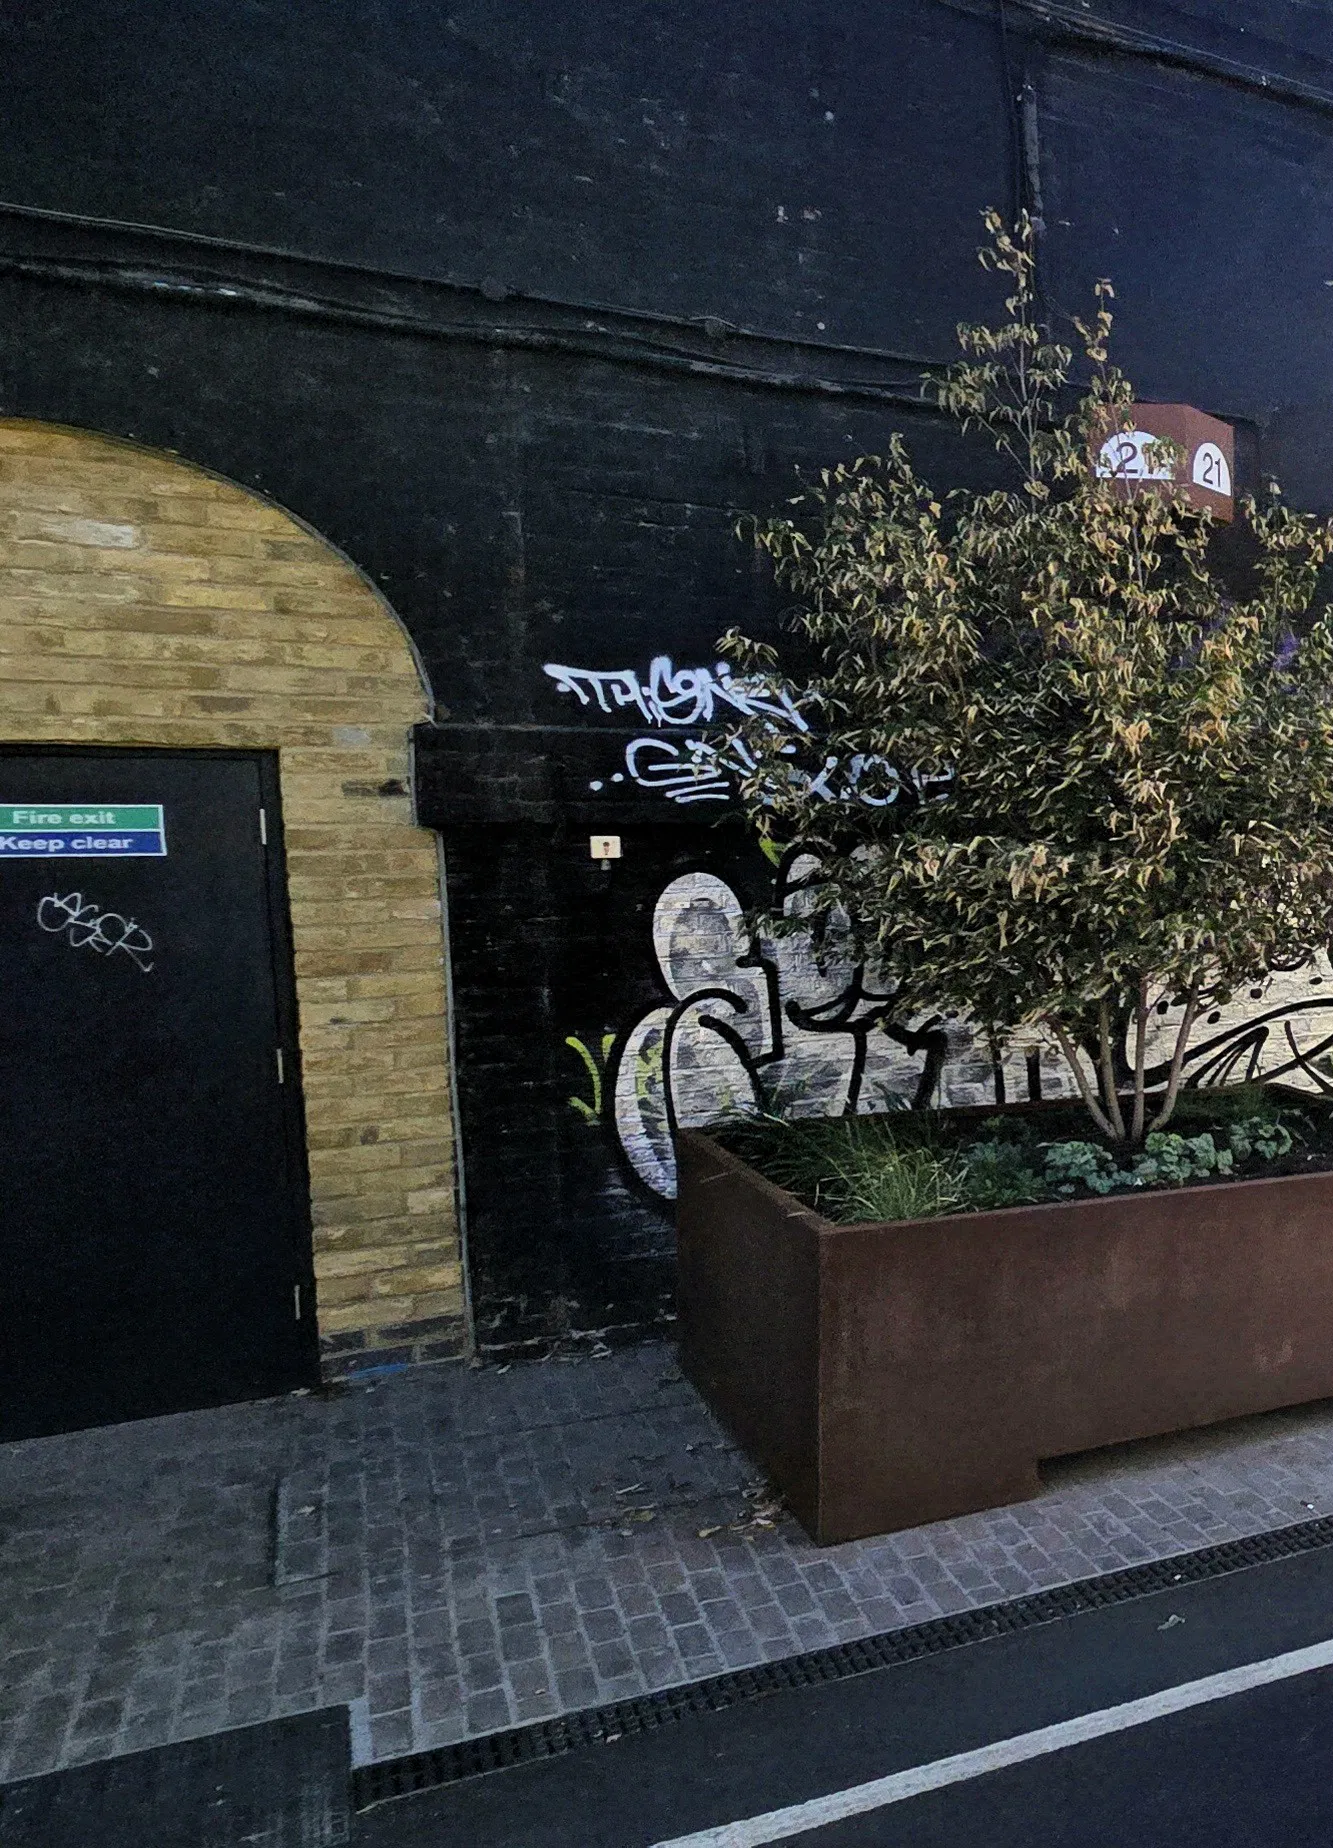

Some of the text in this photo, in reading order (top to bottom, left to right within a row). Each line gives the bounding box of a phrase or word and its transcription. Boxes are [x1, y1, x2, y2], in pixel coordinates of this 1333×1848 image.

[1202, 452, 1222, 488] 21
[12, 810, 117, 825] Fire exit
[0, 836, 134, 852] Keep clear
